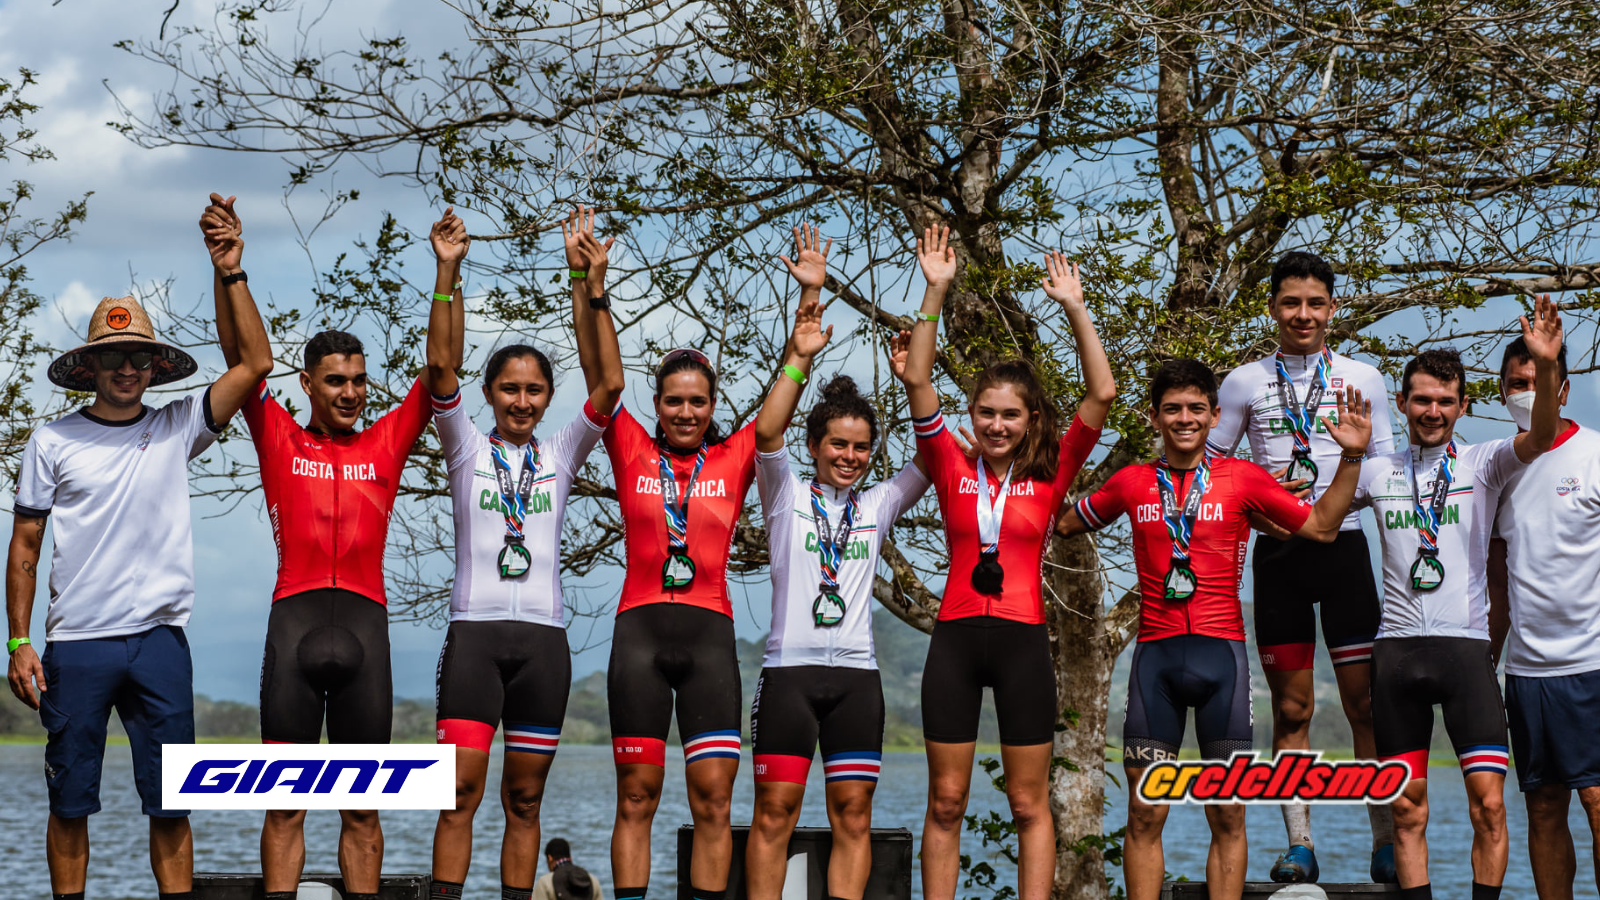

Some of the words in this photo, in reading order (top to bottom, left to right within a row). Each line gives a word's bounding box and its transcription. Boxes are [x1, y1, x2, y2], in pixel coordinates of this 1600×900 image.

[292, 456, 335, 480] COSTA
[343, 463, 377, 481] RICA
[959, 476, 996, 498] COSA
[479, 487, 552, 515] CAEÓN
[1136, 503, 1165, 523] COS
[1198, 502, 1224, 522] ICA
[663, 575, 675, 587] 2
[1164, 588, 1176, 599] 2
